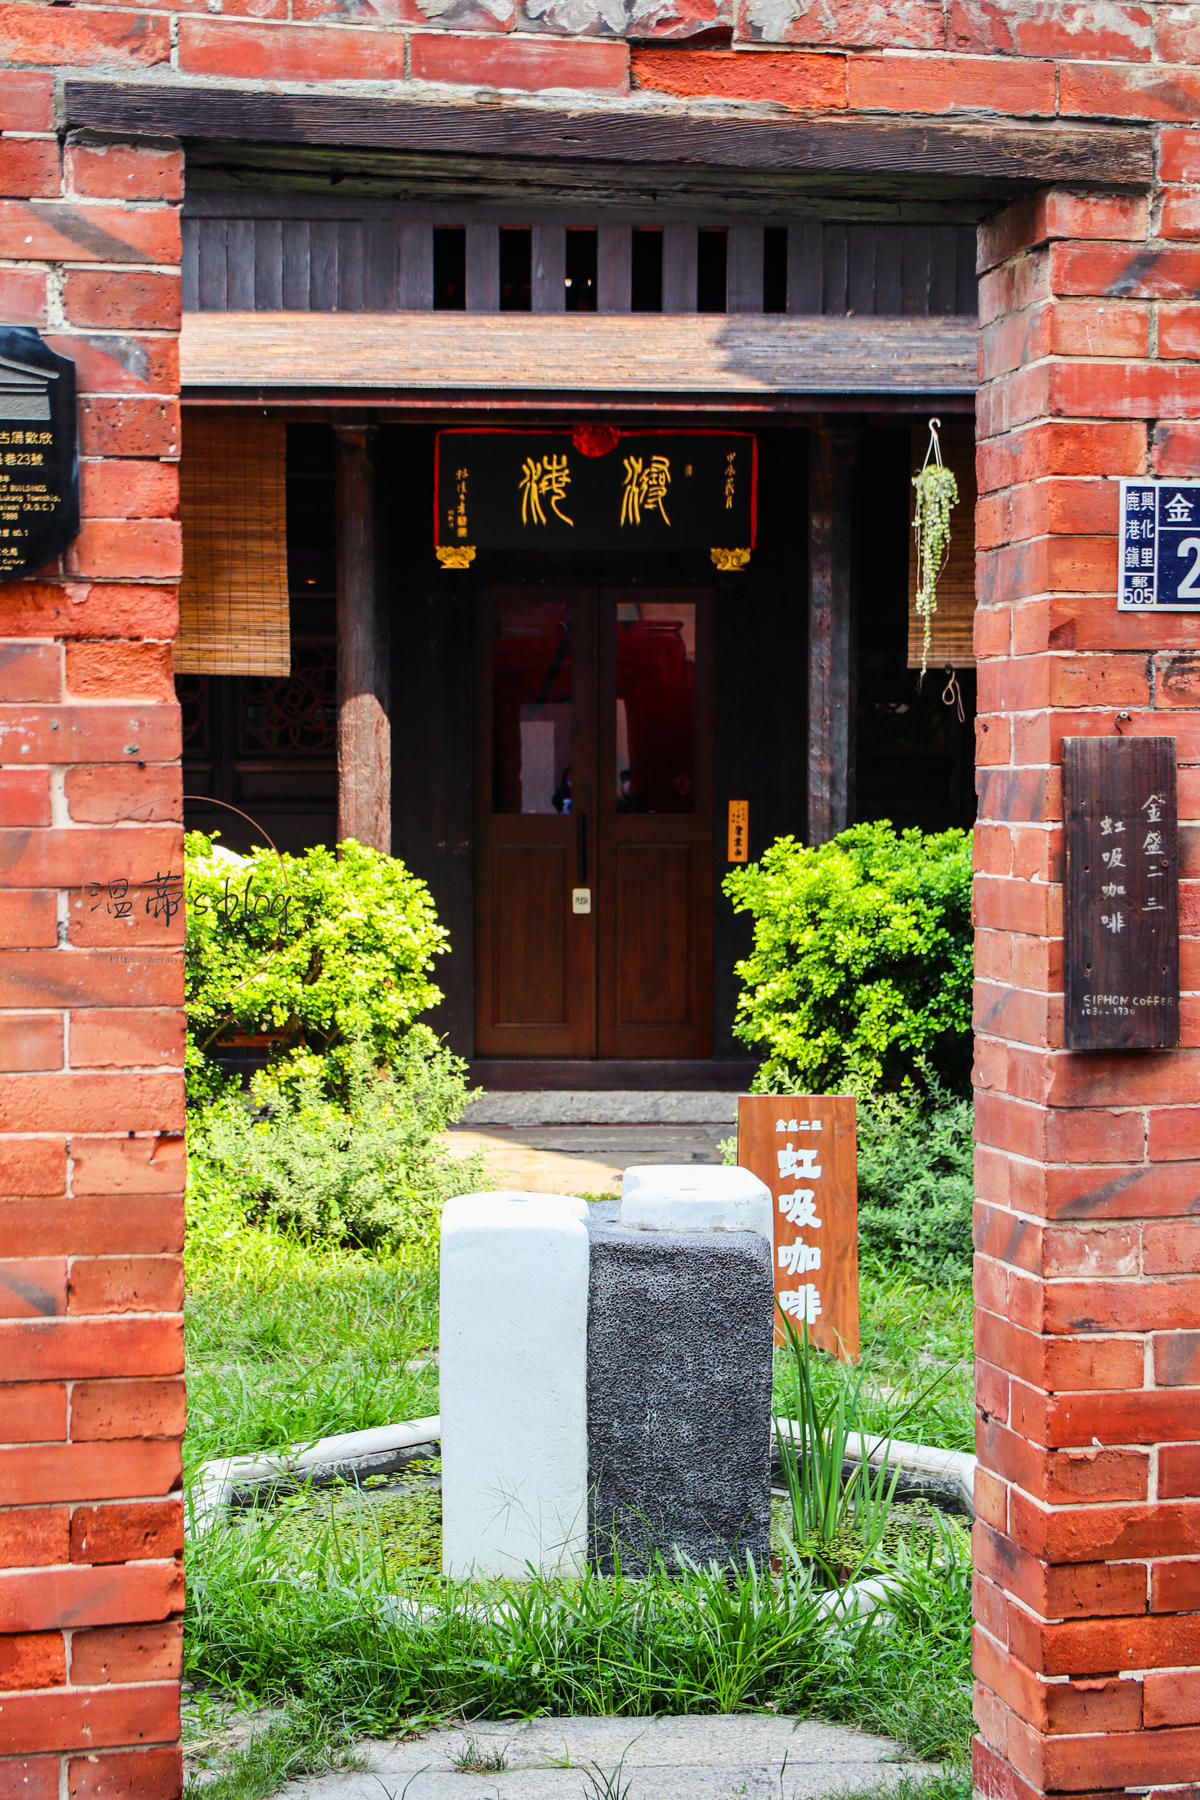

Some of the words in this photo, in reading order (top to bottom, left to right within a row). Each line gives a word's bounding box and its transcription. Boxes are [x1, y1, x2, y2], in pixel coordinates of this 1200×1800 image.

[0, 452, 44, 466] 巷23號
[1125, 491, 1141, 568] 鹿港鎮
[1140, 491, 1155, 568] 興化里
[1164, 492, 1195, 523] 金
[1124, 588, 1154, 604] 505
[1131, 576, 1149, 588] 郵
[1100, 815, 1127, 934] 虹吸咖啡
[1141, 794, 1167, 911] 金盛二三
[1083, 994, 1129, 1007] SIPHON
[777, 1142, 823, 1325] 虹吸咖啡
